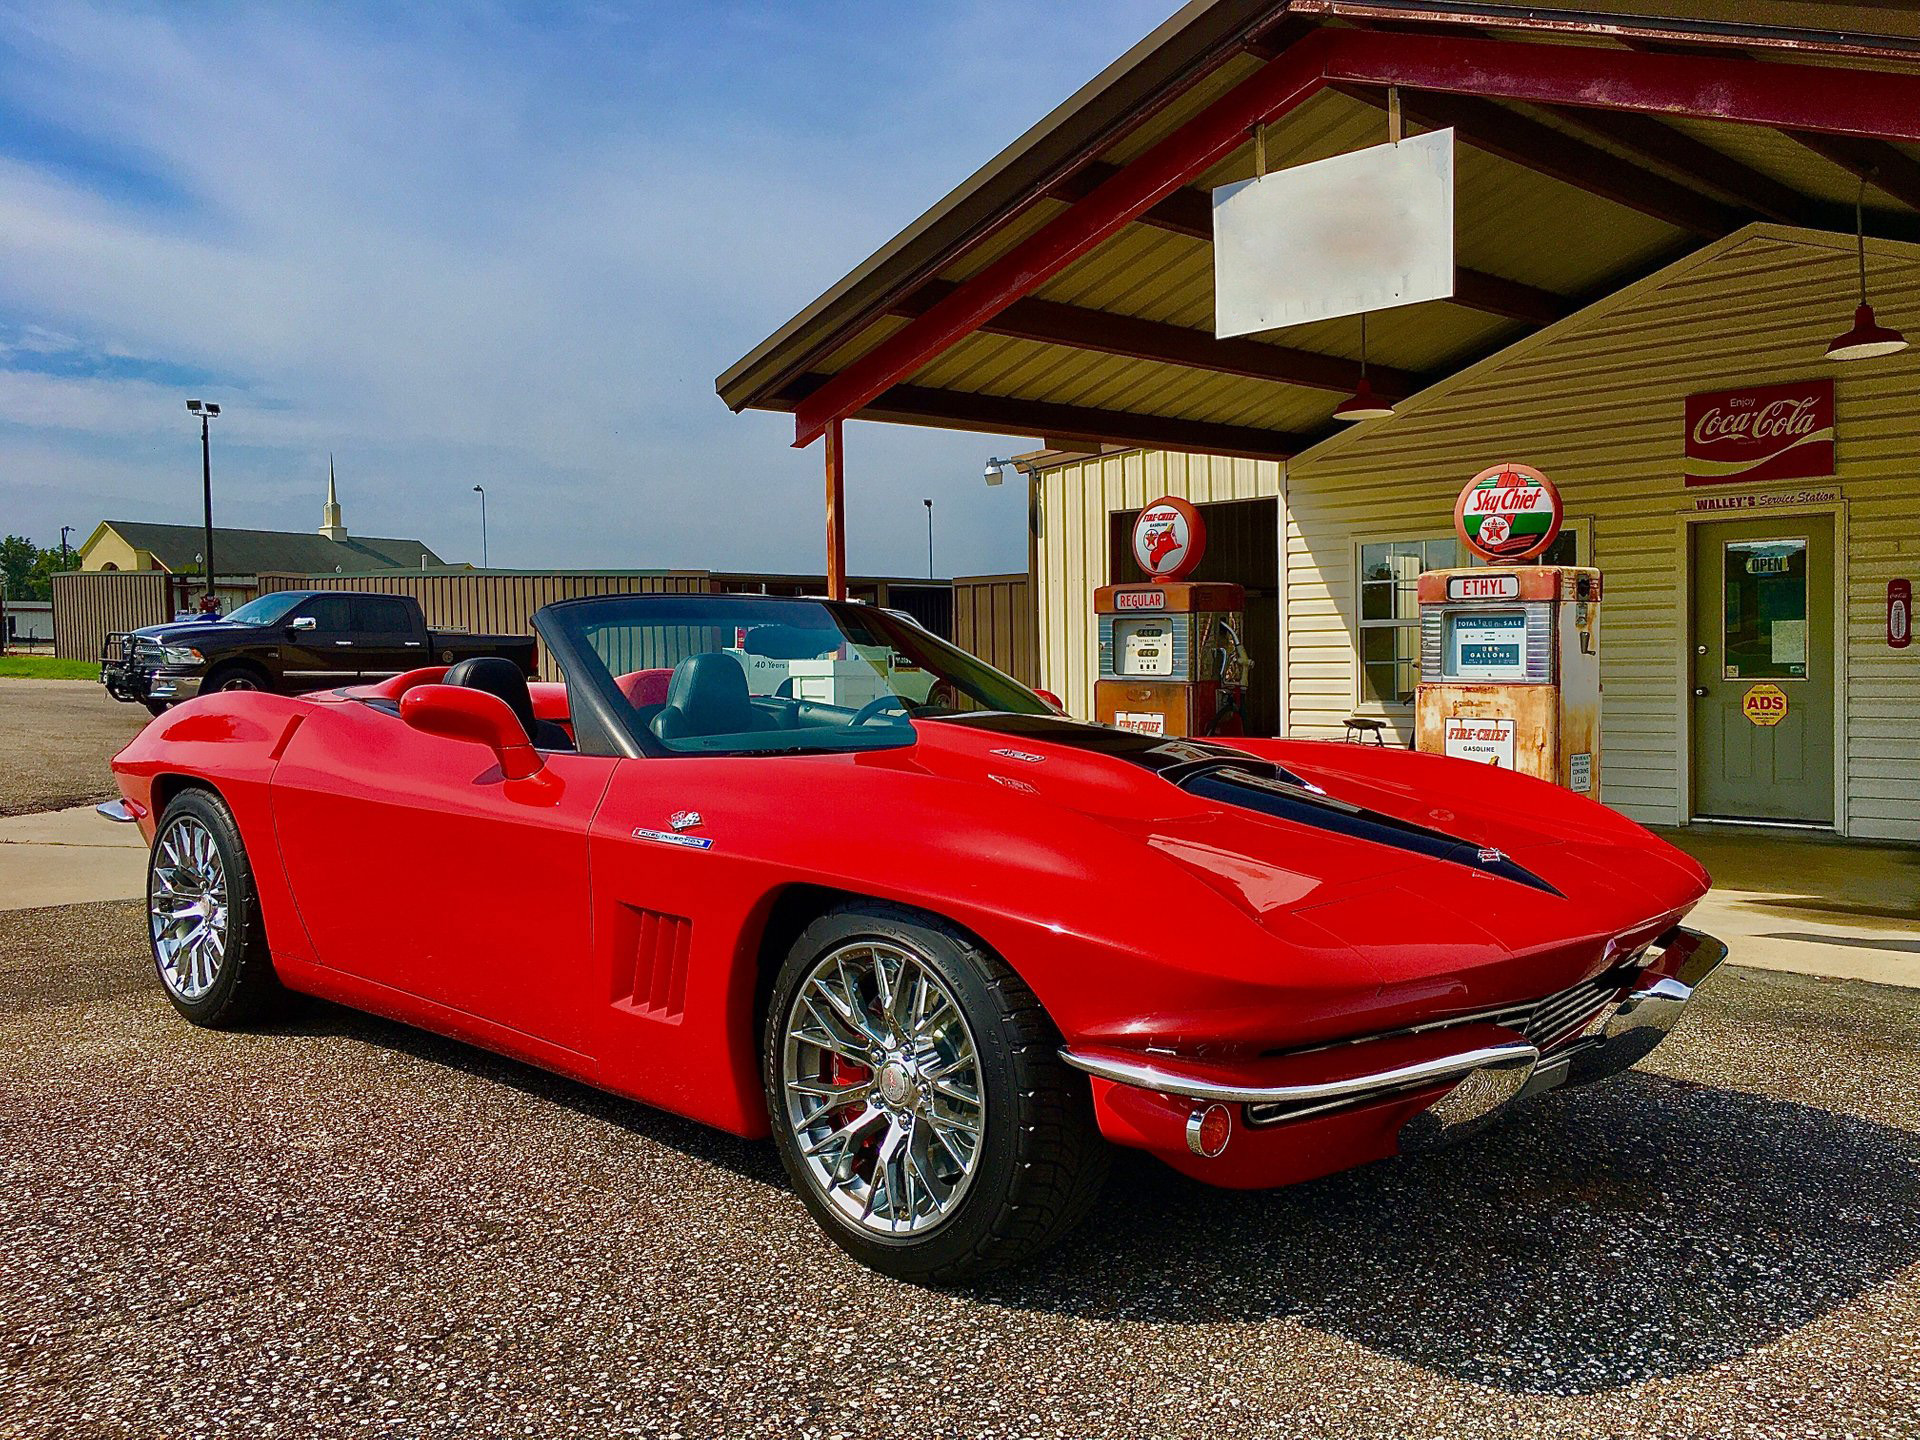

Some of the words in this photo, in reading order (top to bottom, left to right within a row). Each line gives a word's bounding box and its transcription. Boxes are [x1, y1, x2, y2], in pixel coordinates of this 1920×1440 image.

[1730, 397, 1756, 408] Enjoy
[1693, 396, 1821, 444] Coca-Cola
[1473, 489, 1501, 513] Sky
[1501, 487, 1542, 510] Chief
[1696, 496, 1756, 510] WALLEY'S
[1760, 494, 1795, 506] Service
[1797, 491, 1835, 503] Station
[1143, 512, 1178, 523] FIRE-CHIEF
[1752, 557, 1783, 572] OPEN
[1463, 579, 1507, 596] ETHYL
[1120, 594, 1161, 607] REGULAR
[755, 661, 766, 669] 40
[768, 661, 785, 669] Years
[1747, 696, 1784, 710] ADS
[1448, 728, 1511, 742] FIRE-CHIEF
[1462, 745, 1495, 753] GASOLINE
